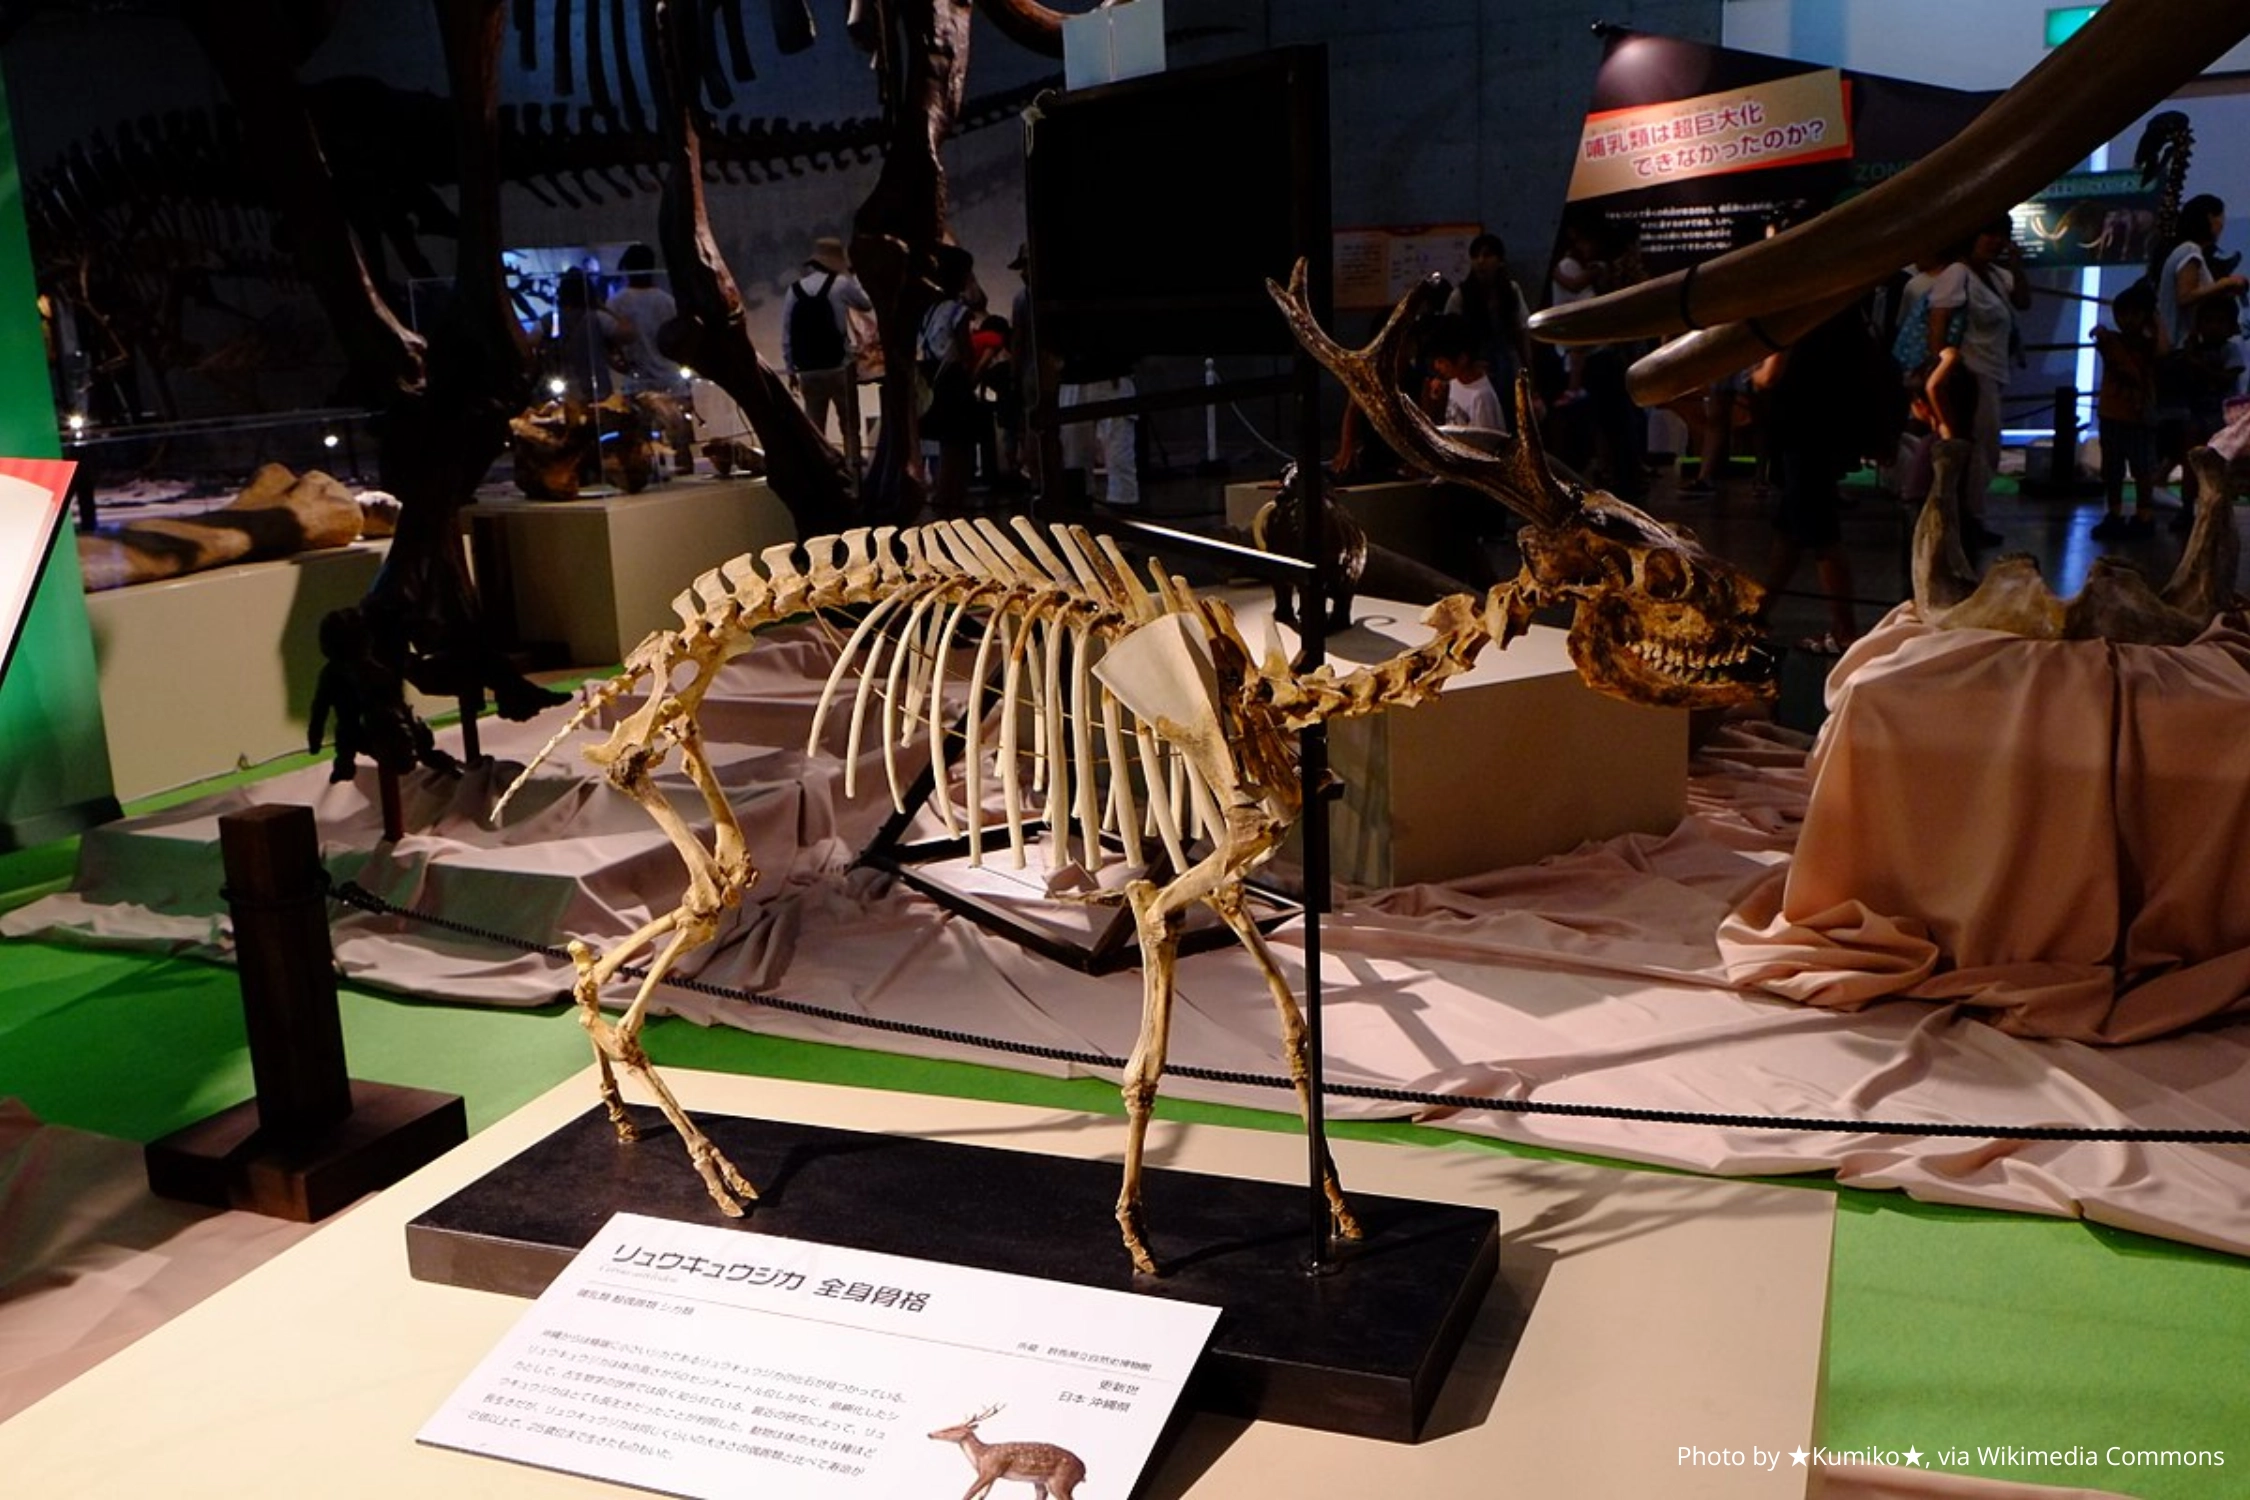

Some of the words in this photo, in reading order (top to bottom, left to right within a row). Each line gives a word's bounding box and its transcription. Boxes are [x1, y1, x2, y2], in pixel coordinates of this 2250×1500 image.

[1585, 104, 1763, 159] 哺乳類は超巨大化
[1633, 120, 1824, 176] できなかったのか?
[612, 1243, 806, 1291] リュウキュウジカ
[813, 1278, 931, 1313] 全身骨格
[1057, 1390, 1088, 1405] 日本
[1087, 1395, 1133, 1413] 沖縄県
[1097, 1379, 1142, 1396] 更新世
